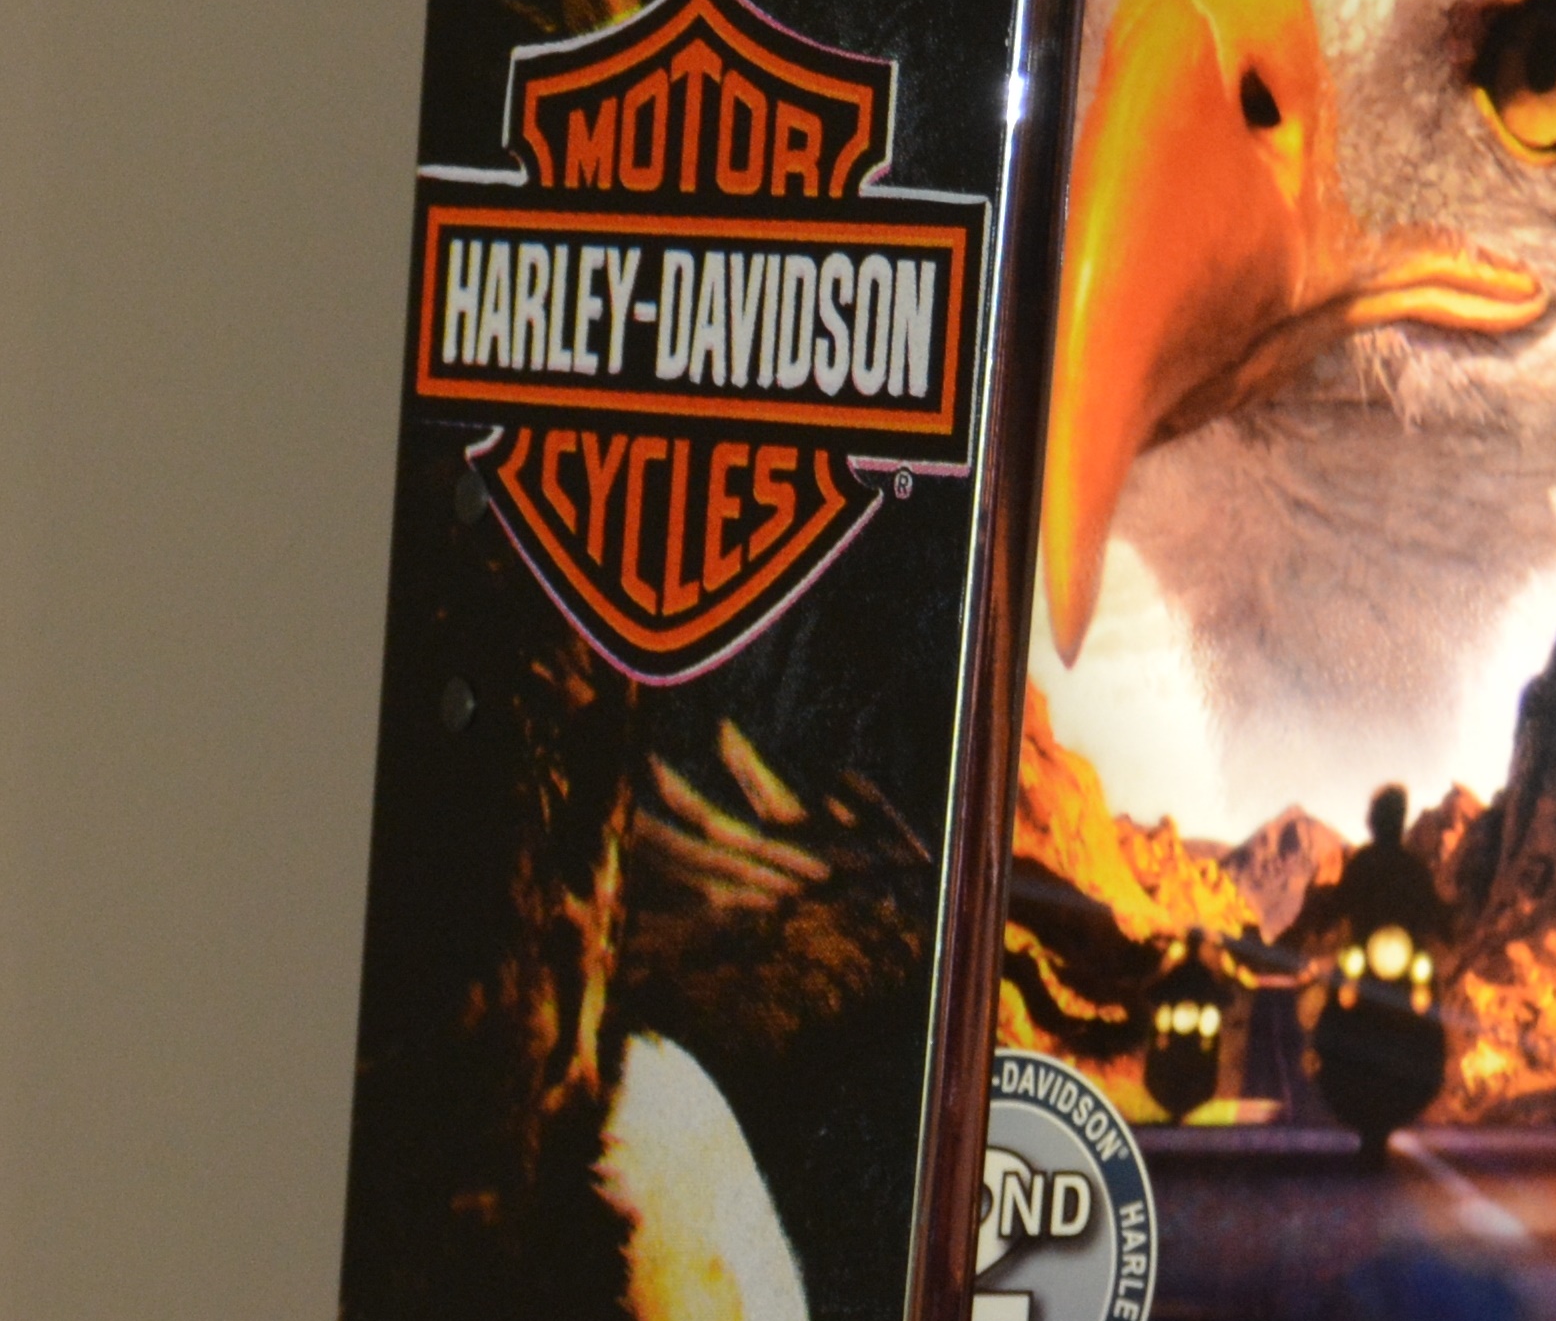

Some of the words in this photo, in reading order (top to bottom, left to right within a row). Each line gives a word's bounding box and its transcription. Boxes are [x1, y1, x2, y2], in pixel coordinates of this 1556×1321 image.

[564, 37, 826, 197] MOTOR
[441, 238, 938, 399] HARLEY-DAVIDSON
[541, 428, 799, 618] CYCLES
